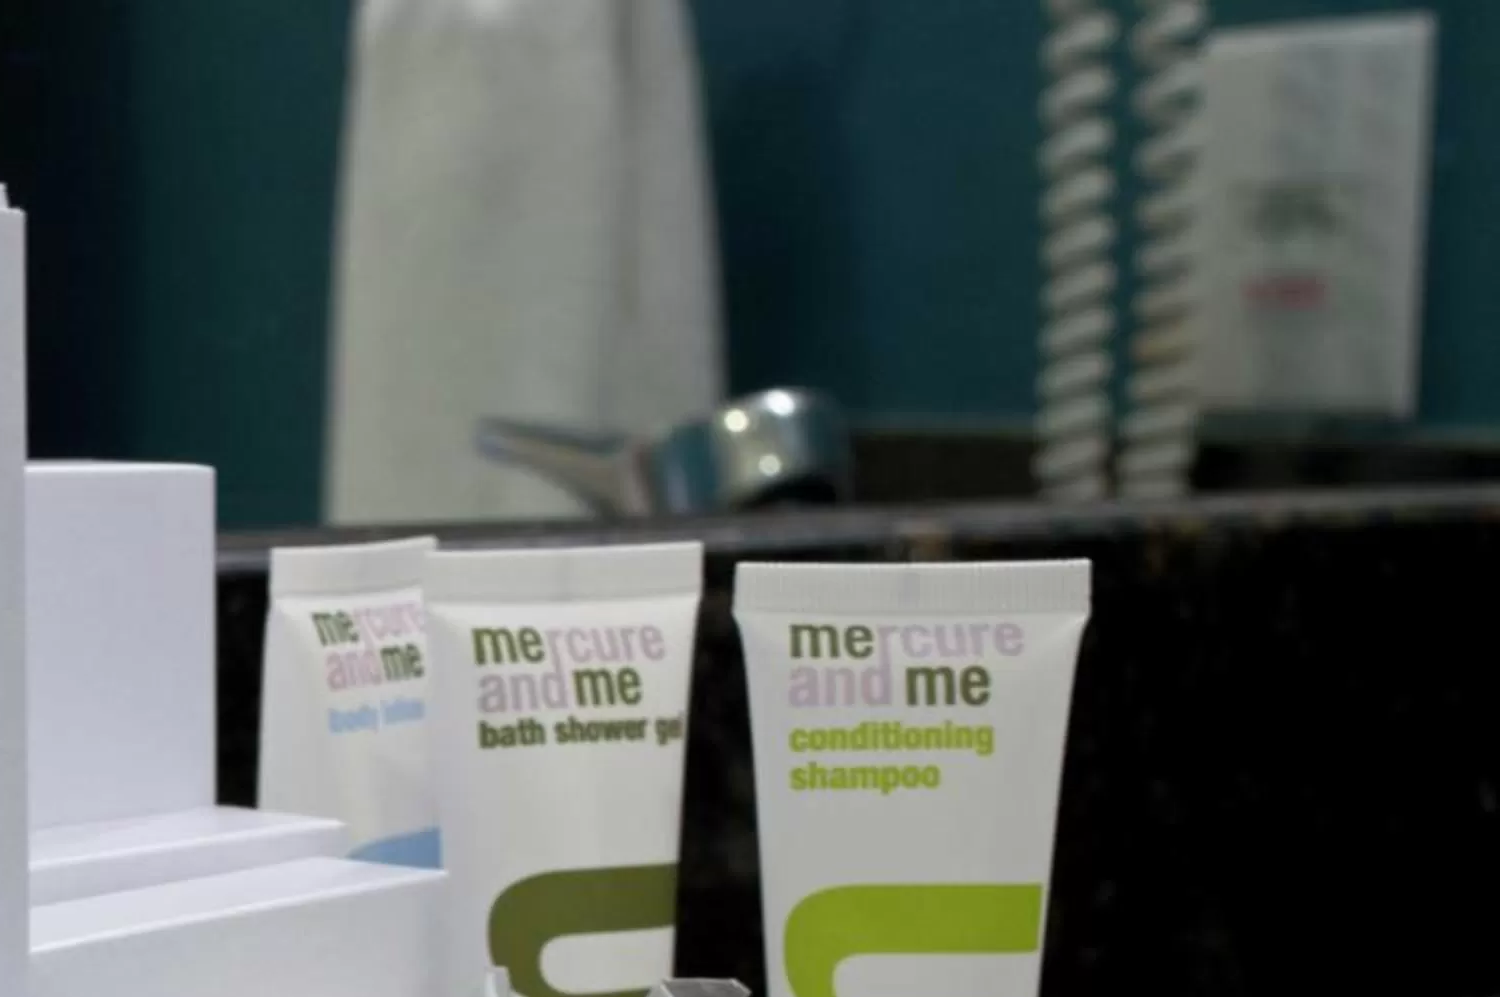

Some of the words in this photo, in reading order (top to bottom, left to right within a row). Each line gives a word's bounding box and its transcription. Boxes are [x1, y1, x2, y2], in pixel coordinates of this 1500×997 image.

[472, 625, 664, 666] mercure
[789, 622, 1025, 660] mercure
[325, 649, 382, 692] and
[380, 643, 425, 681] me
[788, 662, 892, 707] and
[904, 664, 992, 707] me
[479, 666, 569, 713] and
[572, 666, 643, 707] me
[479, 718, 546, 749] bath
[554, 716, 647, 744] shower
[788, 720, 994, 757] conditioning
[789, 761, 941, 795] shampoo
